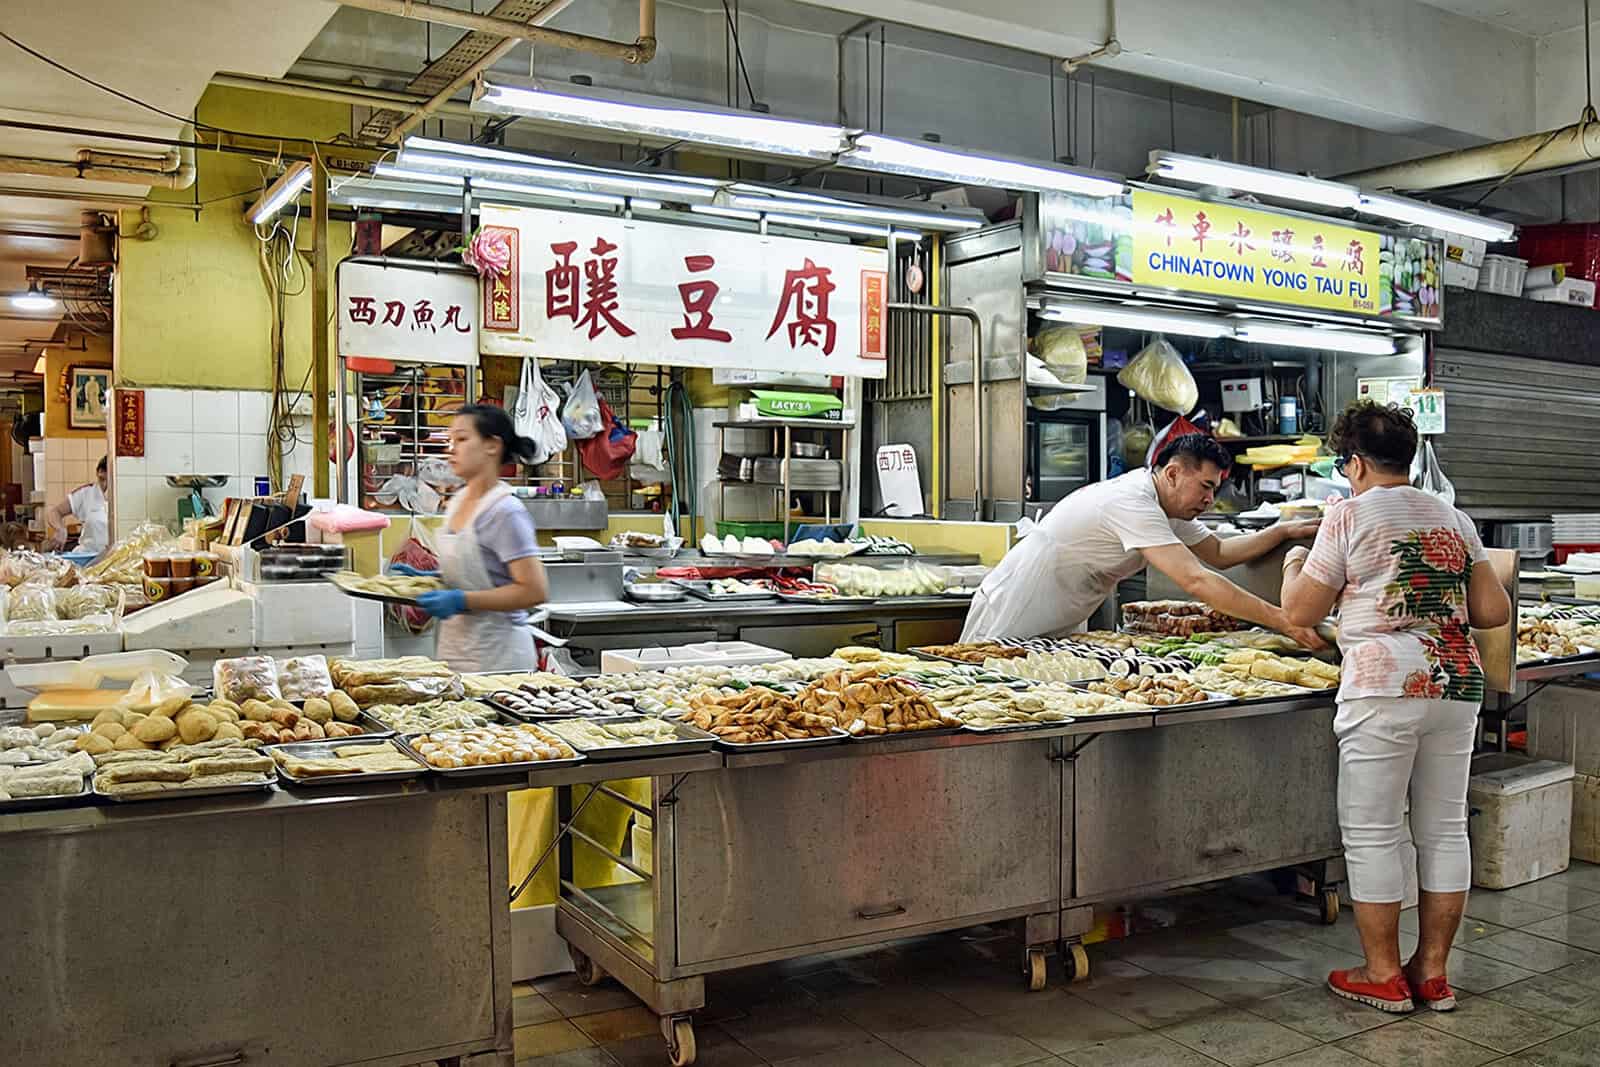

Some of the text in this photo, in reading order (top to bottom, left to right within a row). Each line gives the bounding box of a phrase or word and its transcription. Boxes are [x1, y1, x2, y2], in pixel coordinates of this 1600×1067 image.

[545, 237, 836, 357] 釀豆腐
[1149, 252, 1369, 299] CHINATOWN YONG TAU FU
[348, 296, 471, 335] 西刀魚丸
